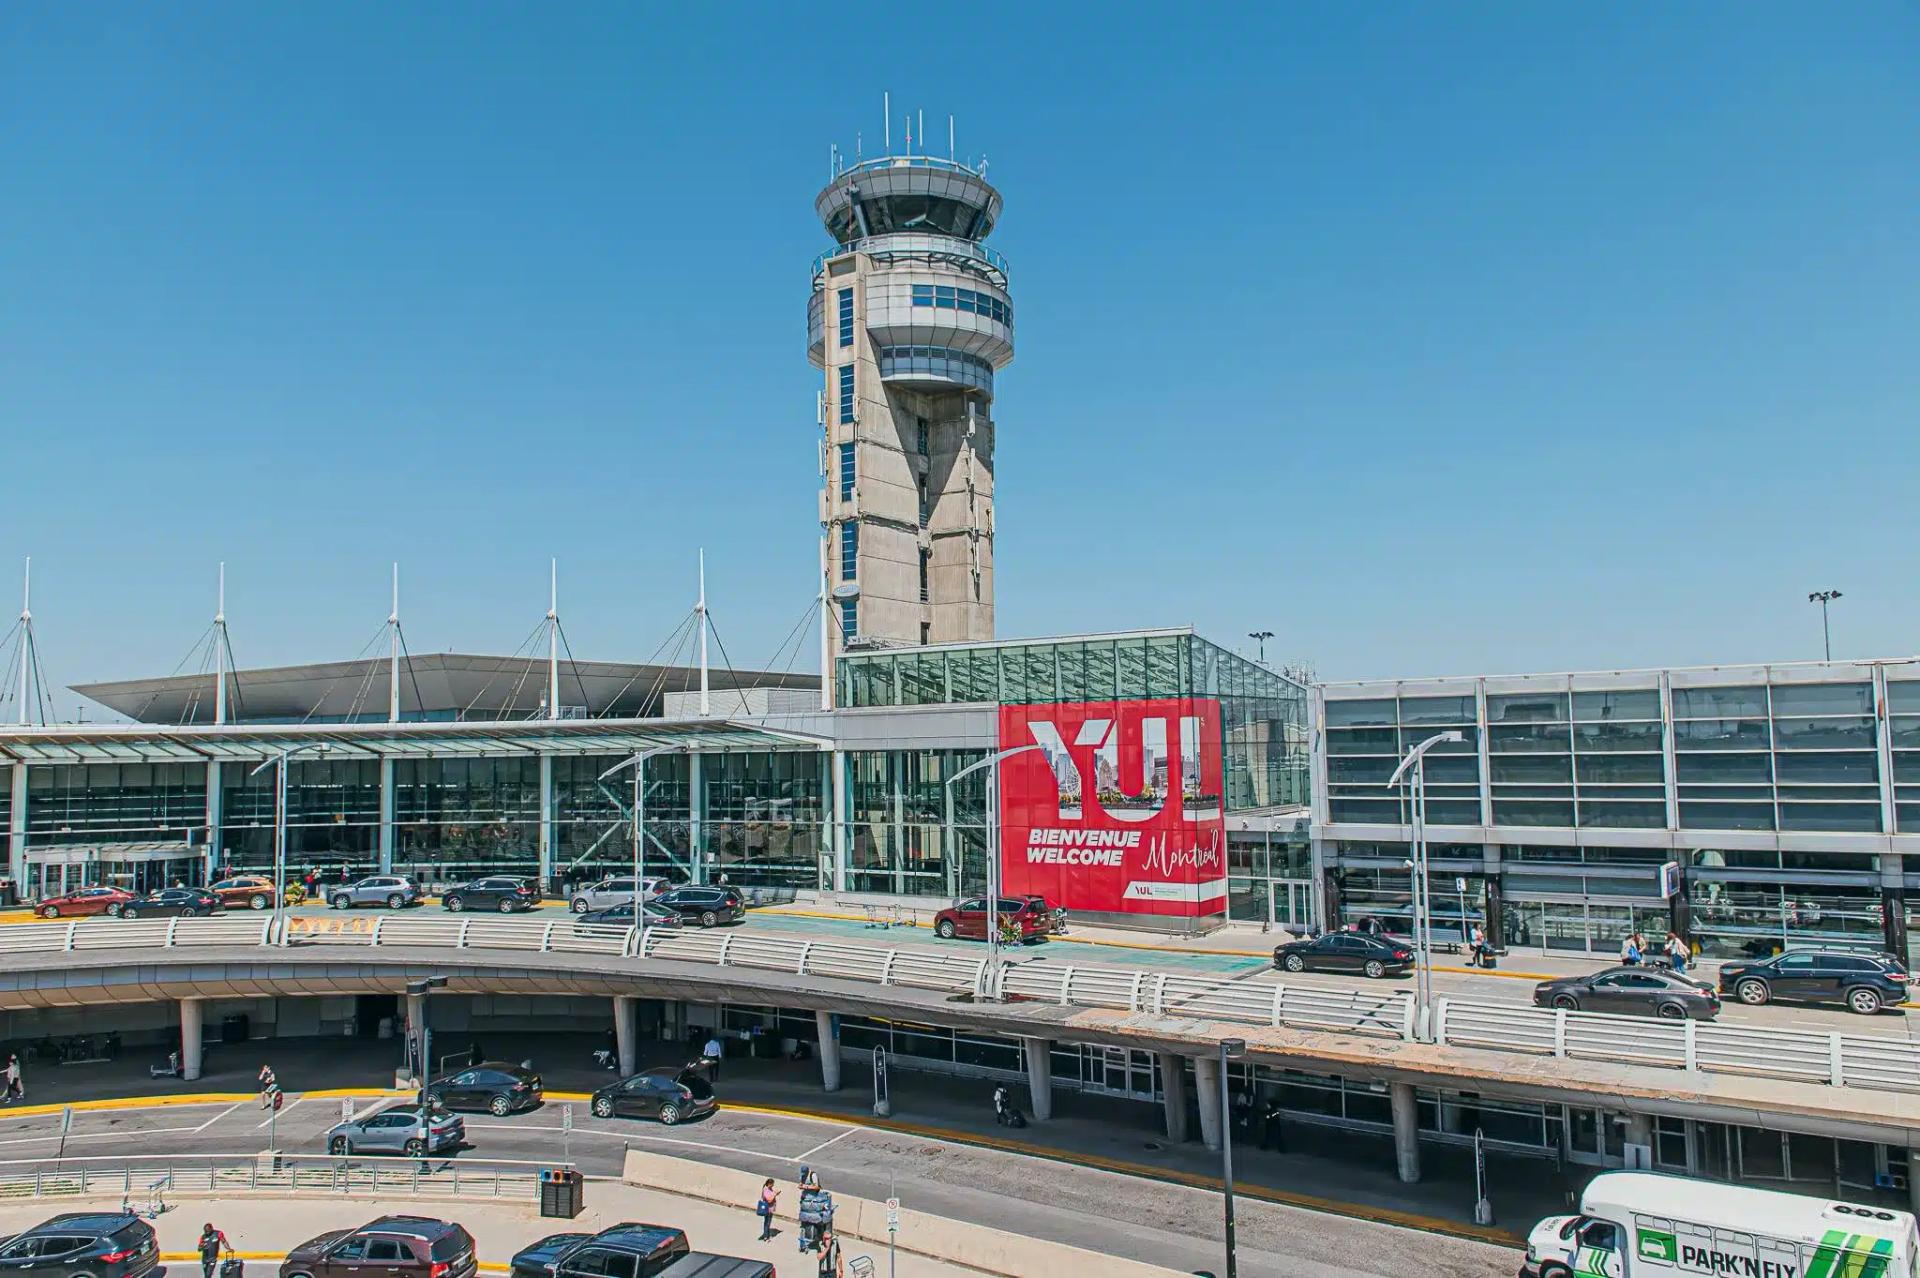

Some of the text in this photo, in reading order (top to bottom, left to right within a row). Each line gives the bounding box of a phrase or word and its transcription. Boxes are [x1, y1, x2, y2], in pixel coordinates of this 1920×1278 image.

[1027, 716, 1221, 822] YUL
[1028, 828, 1142, 848] BIENVENUE
[1141, 828, 1219, 877] Montréal
[1026, 847, 1124, 867] WELCOME
[1682, 1245, 1759, 1278] PARK'N
